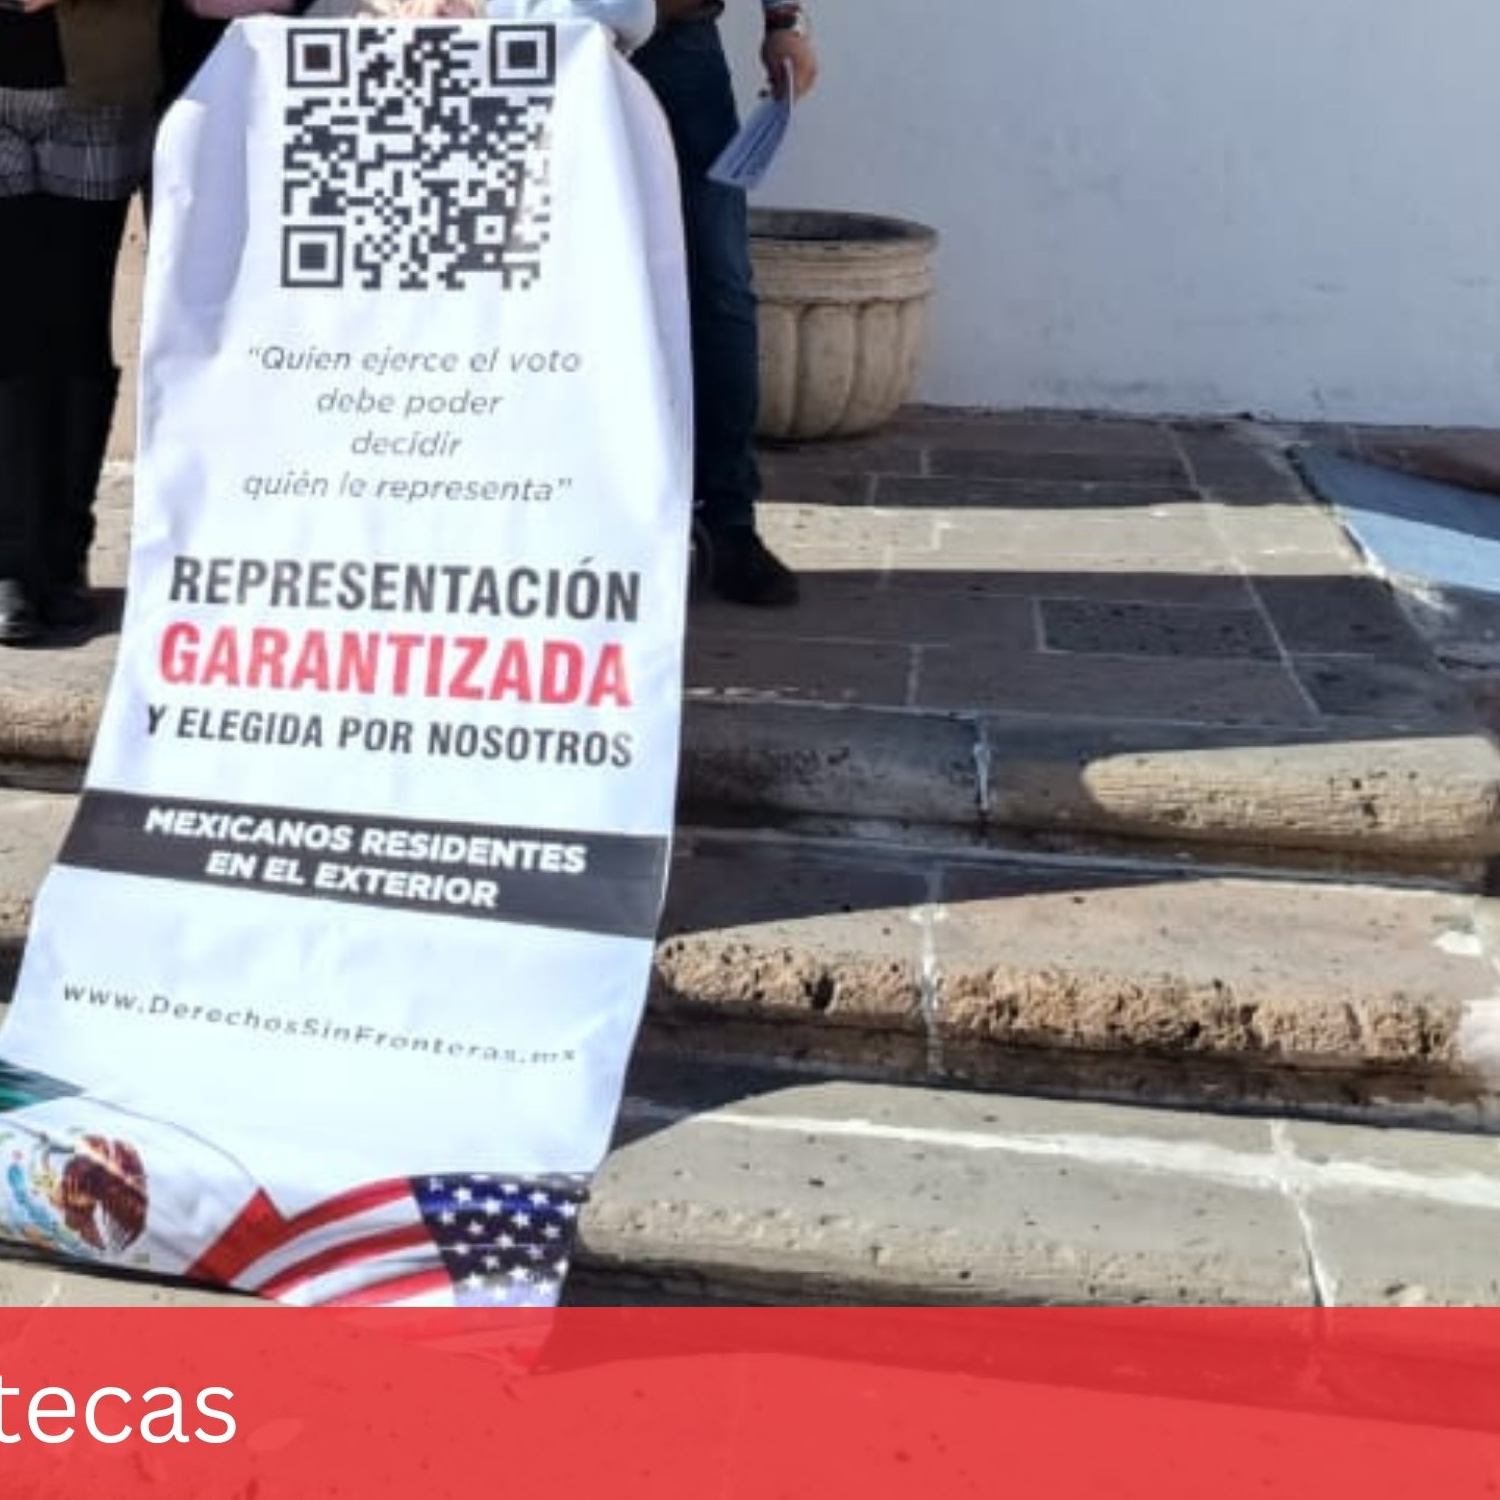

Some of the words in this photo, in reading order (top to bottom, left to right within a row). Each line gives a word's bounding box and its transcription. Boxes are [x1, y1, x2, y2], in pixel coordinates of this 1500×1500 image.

[361, 345, 458, 375] ejerce
[469, 346, 500, 372] el
[510, 349, 581, 373] voto
[317, 386, 394, 413] debe
[404, 388, 504, 418] poder
[351, 429, 462, 457] decidir
[243, 469, 329, 500] quién
[339, 470, 368, 497] le
[169, 555, 641, 622] REPRESENTACIÓN
[158, 621, 632, 707] GARANTIZADA
[147, 704, 166, 736] Y
[176, 707, 323, 746] ELEGIDA
[338, 717, 412, 755] POR
[427, 722, 633, 768] NOSOTROS
[144, 807, 353, 852] MEXICANOS
[360, 827, 588, 875] RESIDENTES
[205, 850, 256, 879] EN
[262, 856, 306, 885] EL
[314, 862, 499, 908] EXTERIOR
[63, 983, 576, 1064] www.DerechosSinFronteras.mx
